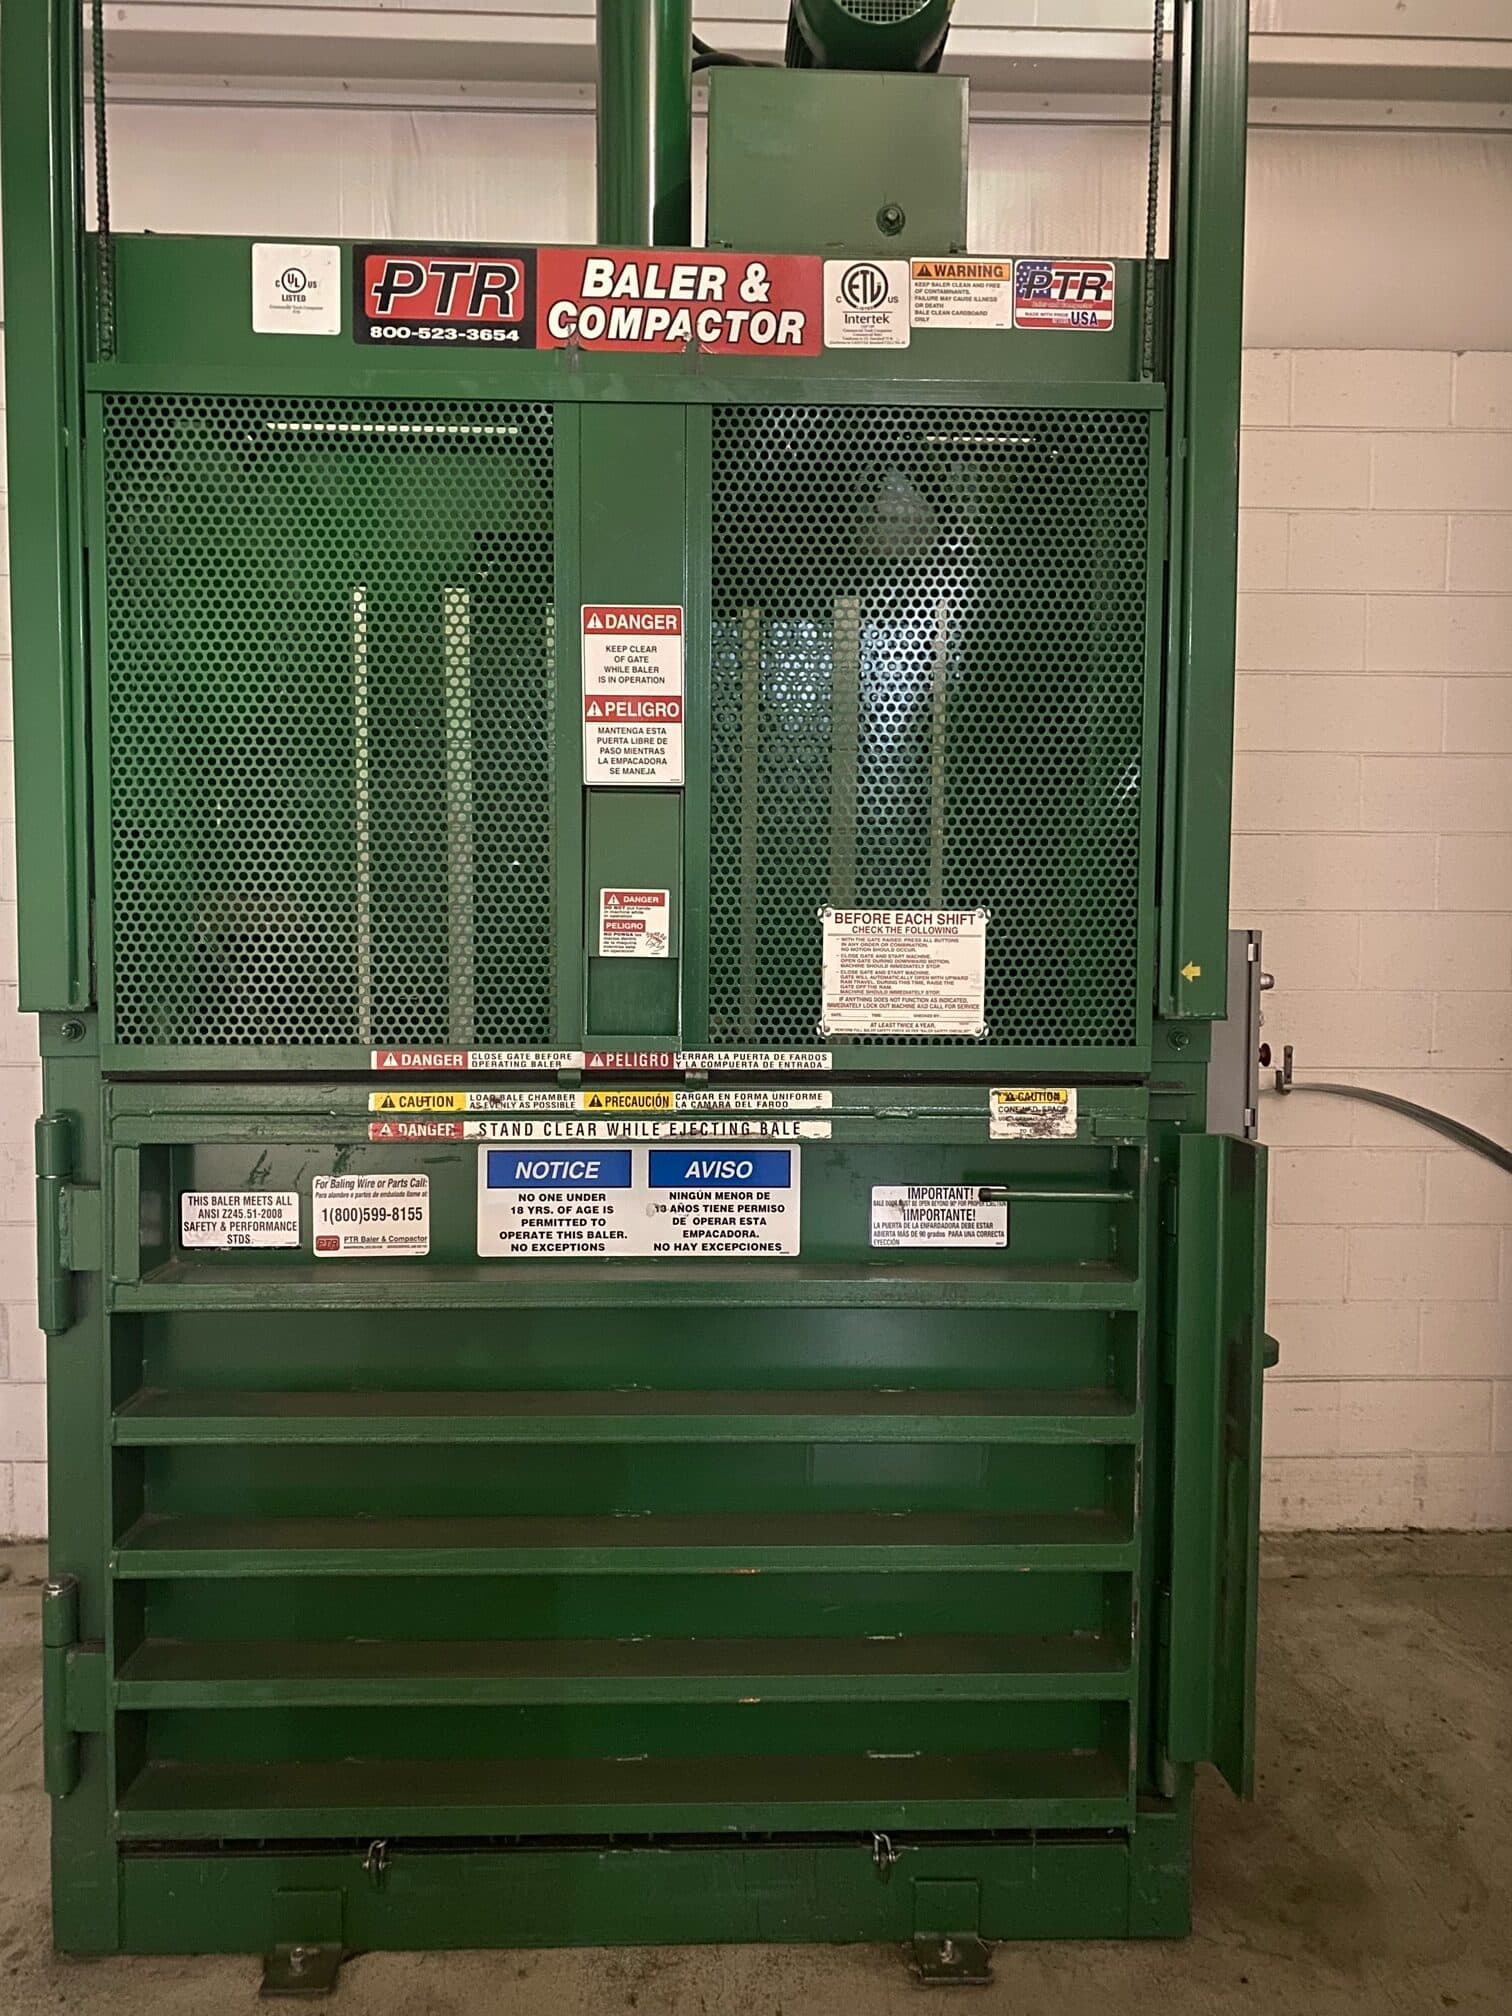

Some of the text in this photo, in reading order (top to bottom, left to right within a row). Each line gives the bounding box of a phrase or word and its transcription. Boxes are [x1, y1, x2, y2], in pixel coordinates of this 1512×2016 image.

[934, 264, 1004, 278] WARNING
[581, 258, 772, 303] BALER &
[1024, 271, 1107, 301] PTR
[371, 259, 519, 318] PTR
[282, 294, 306, 302] LISTED
[548, 301, 806, 345] COMPACTOR
[844, 313, 890, 324] Intertek
[1071, 312, 1098, 326] USA
[370, 326, 520, 342] 800-523-3654
[605, 615, 677, 630] DANGER
[605, 702, 680, 717] PELIGRO
[835, 913, 976, 925] BEFORE EACH SHIFT
[402, 1055, 463, 1066] DANGER
[606, 1054, 669, 1067] PELIGRO
[676, 1060, 680, 1068] Y
[400, 1096, 453, 1107] CAUTION
[605, 1093, 669, 1108] PRECAUCIÓN
[676, 1093, 715, 1101] CARGAR
[719, 1093, 731, 1101] EN
[772, 1093, 823, 1101] UNIFORME
[479, 1123, 533, 1136] STAND
[544, 1123, 596, 1136] CLEAR
[608, 1123, 660, 1136] WHILE
[670, 1122, 750, 1135] EJECTING
[760, 1122, 801, 1135] BALE
[515, 1161, 600, 1179] NOTICE
[685, 1161, 753, 1178] AVISO
[316, 1179, 328, 1188] For
[330, 1179, 354, 1190] Baling
[357, 1179, 375, 1188] Wire
[387, 1179, 408, 1188] Parts
[410, 1179, 427, 1188] Call:
[518, 1193, 606, 1202] NO ONE UNDER
[670, 1190, 770, 1200] NINGÚN MENOR DE
[908, 1188, 974, 1199] IMPORTANT!
[189, 1196, 292, 1206] THIS BALER MEETS ALL
[198, 1209, 282, 1218] ANSI Z245.51-2008
[511, 1206, 613, 1214] 18 YRS. OF AGE IS
[670, 1203, 699, 1212] AÑOS
[737, 1204, 785, 1213] PERMISO
[322, 1207, 423, 1225] 1(800)599-8155
[904, 1209, 976, 1221] ¡IMPORTANTE!
[184, 1222, 297, 1231] SAFETY & PERFORMANCE
[521, 1218, 606, 1227] PERMITTED TO
[673, 1217, 766, 1225] DE OPERAR ESTA
[227, 1234, 254, 1244] STDS.
[499, 1231, 627, 1239] OPERATE THIS BALER.
[683, 1230, 760, 1238] EMPACADORA.
[511, 1243, 605, 1252] NO EXCEPTIONS
[654, 1243, 782, 1251] NO HAY EXCEPCIONES
